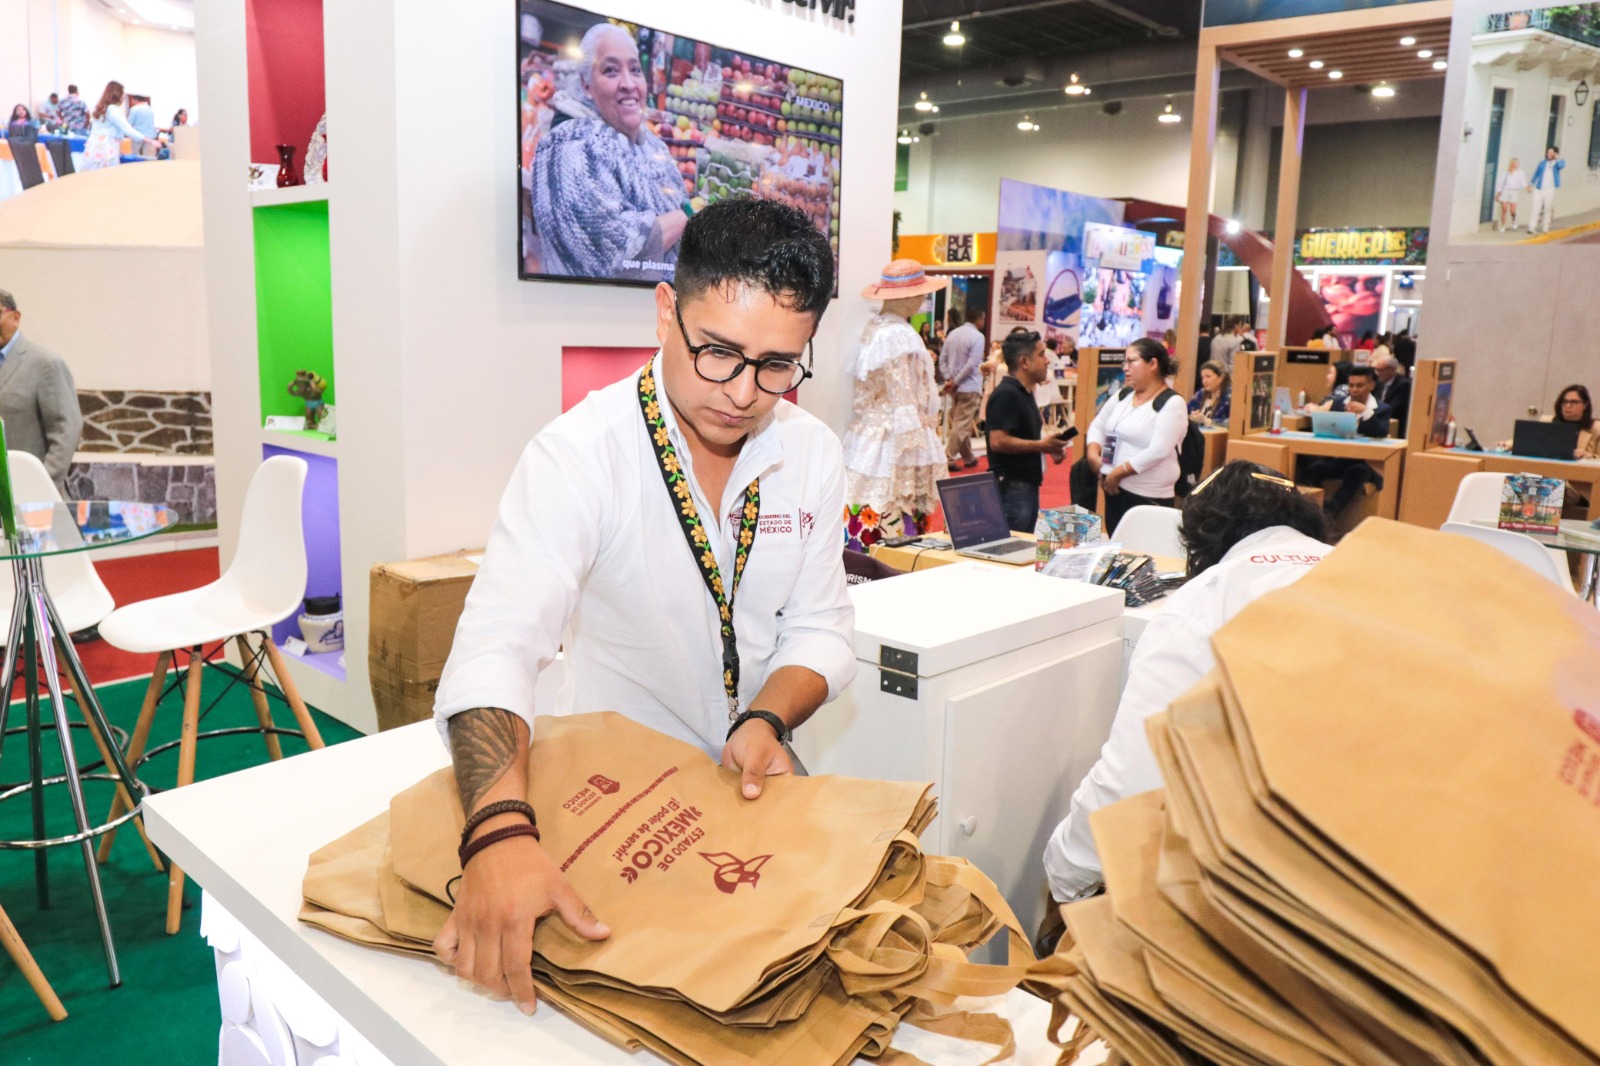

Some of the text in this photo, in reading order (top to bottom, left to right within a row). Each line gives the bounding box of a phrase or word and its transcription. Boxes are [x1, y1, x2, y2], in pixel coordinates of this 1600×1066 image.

[947, 234, 973, 249] PUE
[622, 259, 675, 271] que plasma
[947, 248, 972, 262] BLA
[759, 525, 793, 534] MÉXICO
[562, 787, 591, 809] MÉXICO
[570, 791, 597, 814] ESTADO DE
[612, 796, 681, 862] ¡El poder de servir!
[631, 807, 699, 870] MÉXICO
[656, 827, 705, 872] ESTADO DE
